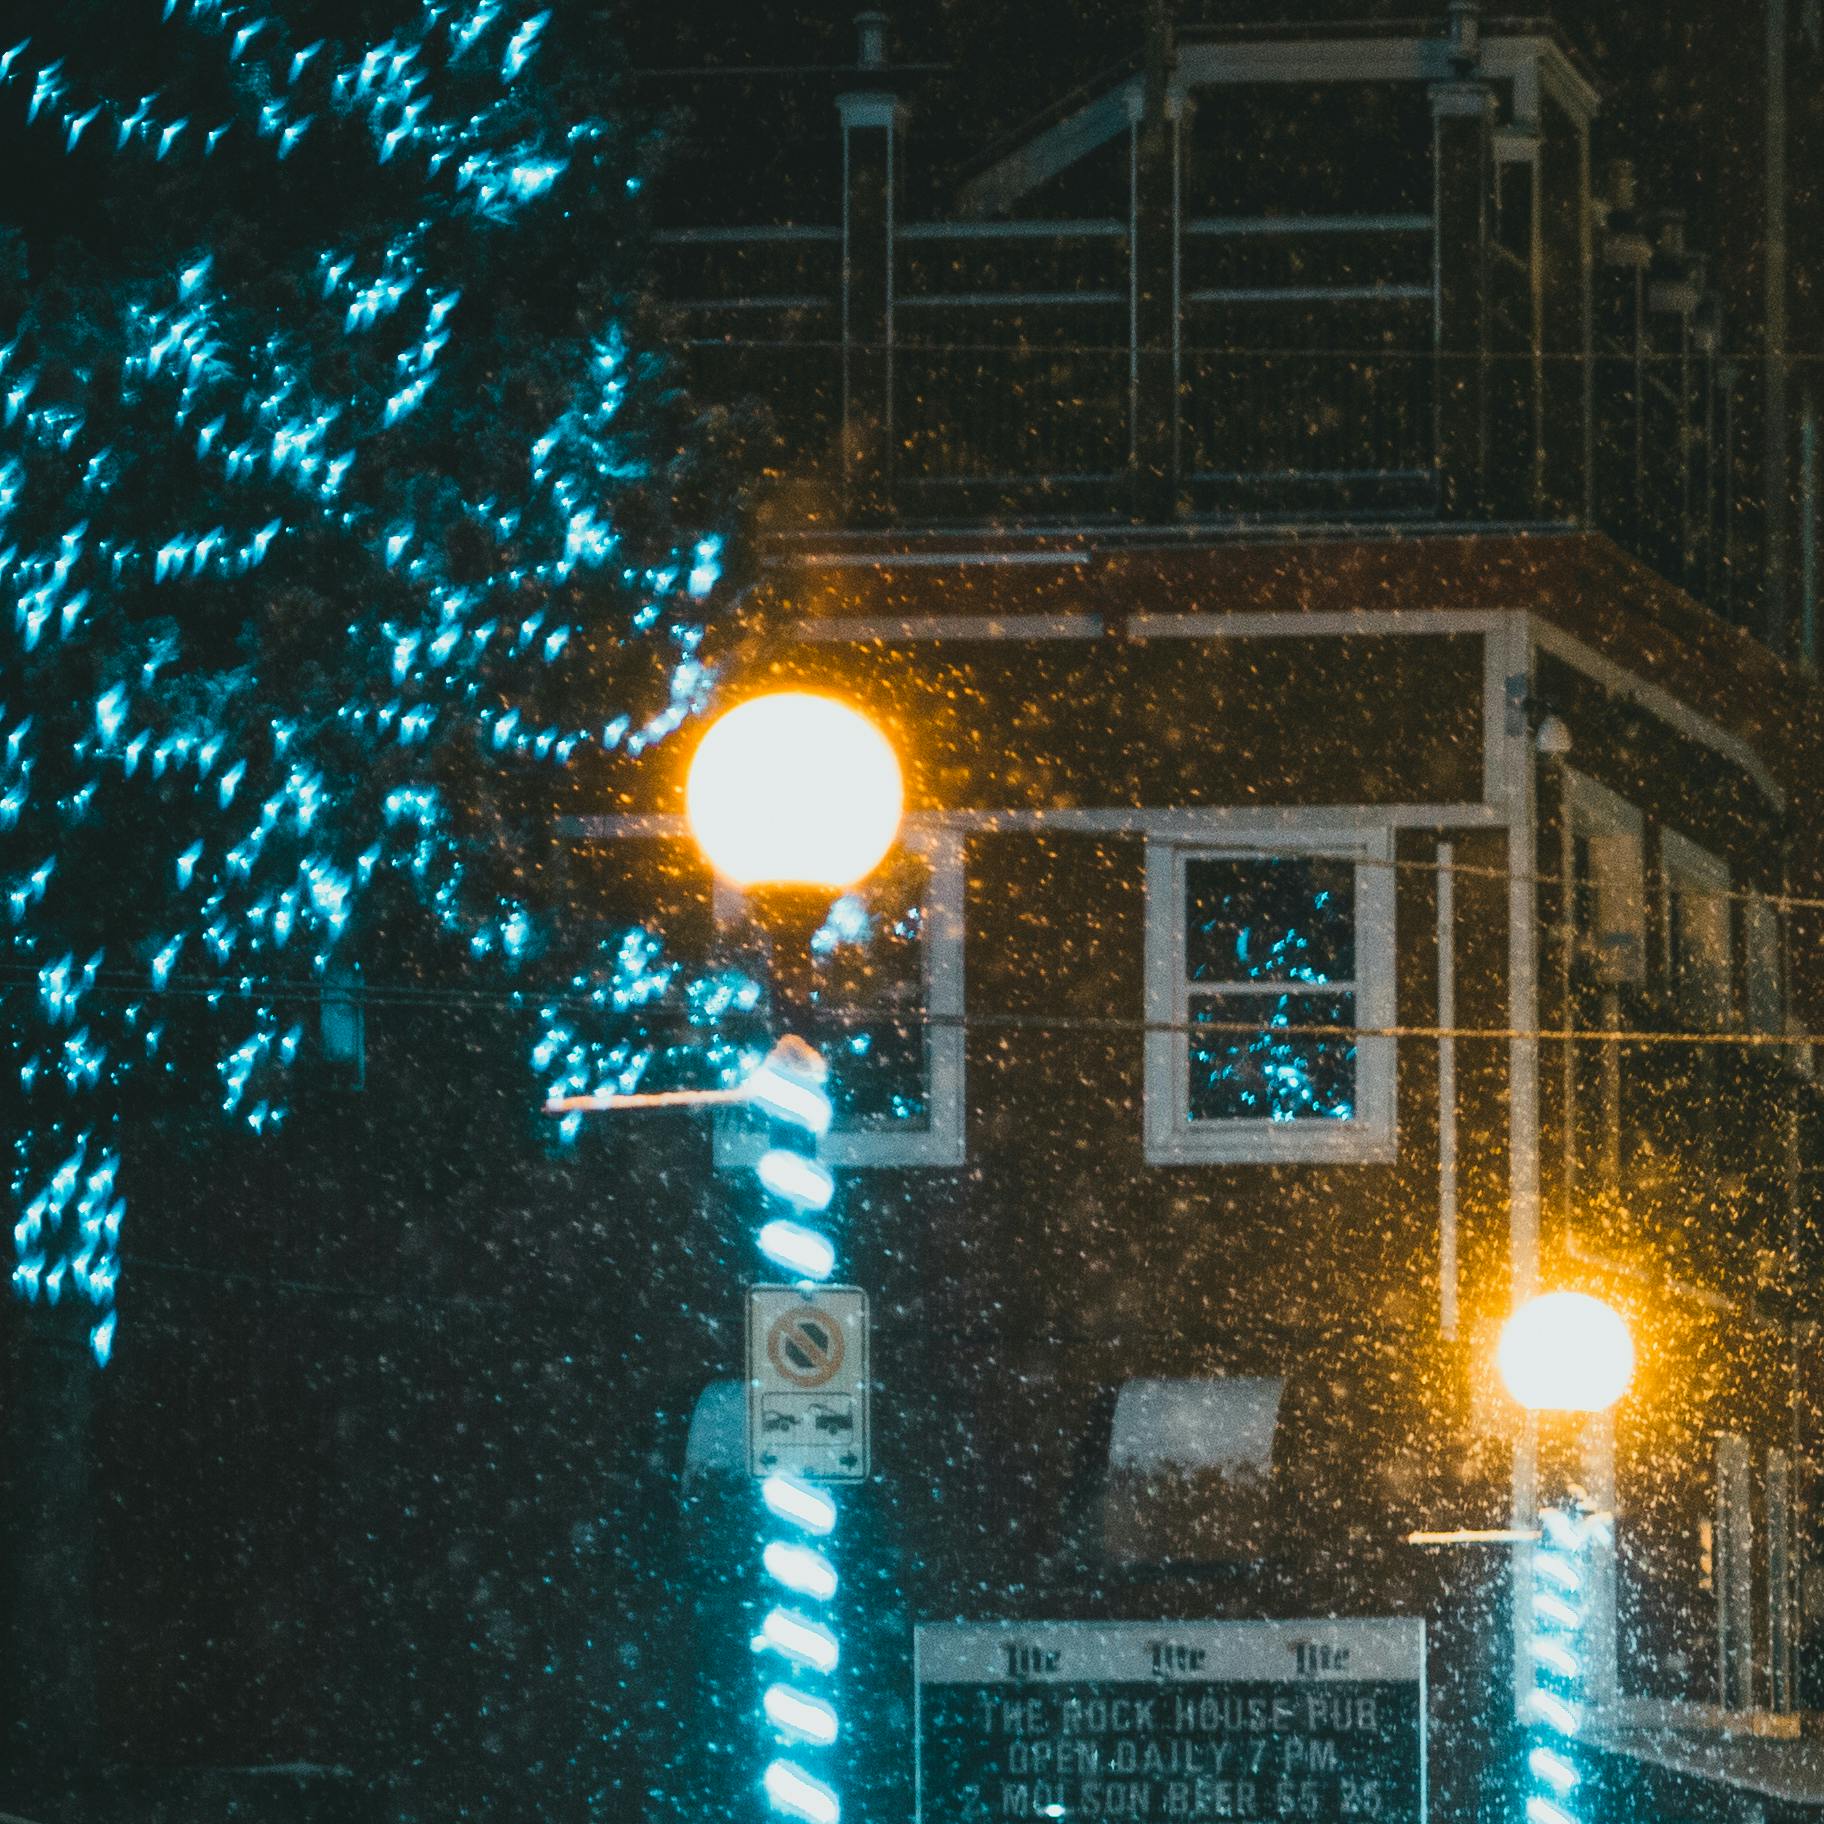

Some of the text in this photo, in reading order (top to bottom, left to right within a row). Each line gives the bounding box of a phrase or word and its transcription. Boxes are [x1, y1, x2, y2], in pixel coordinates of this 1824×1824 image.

[980, 1696, 1378, 1734] THE ROCK HOUSE PUB
[1008, 1740, 1099, 1773] OPEN
[1117, 1739, 1230, 1773] DAILY
[1284, 1738, 1335, 1772] PM
[1002, 1782, 1148, 1817] MOLSON
[1167, 1780, 1258, 1816] BEER
